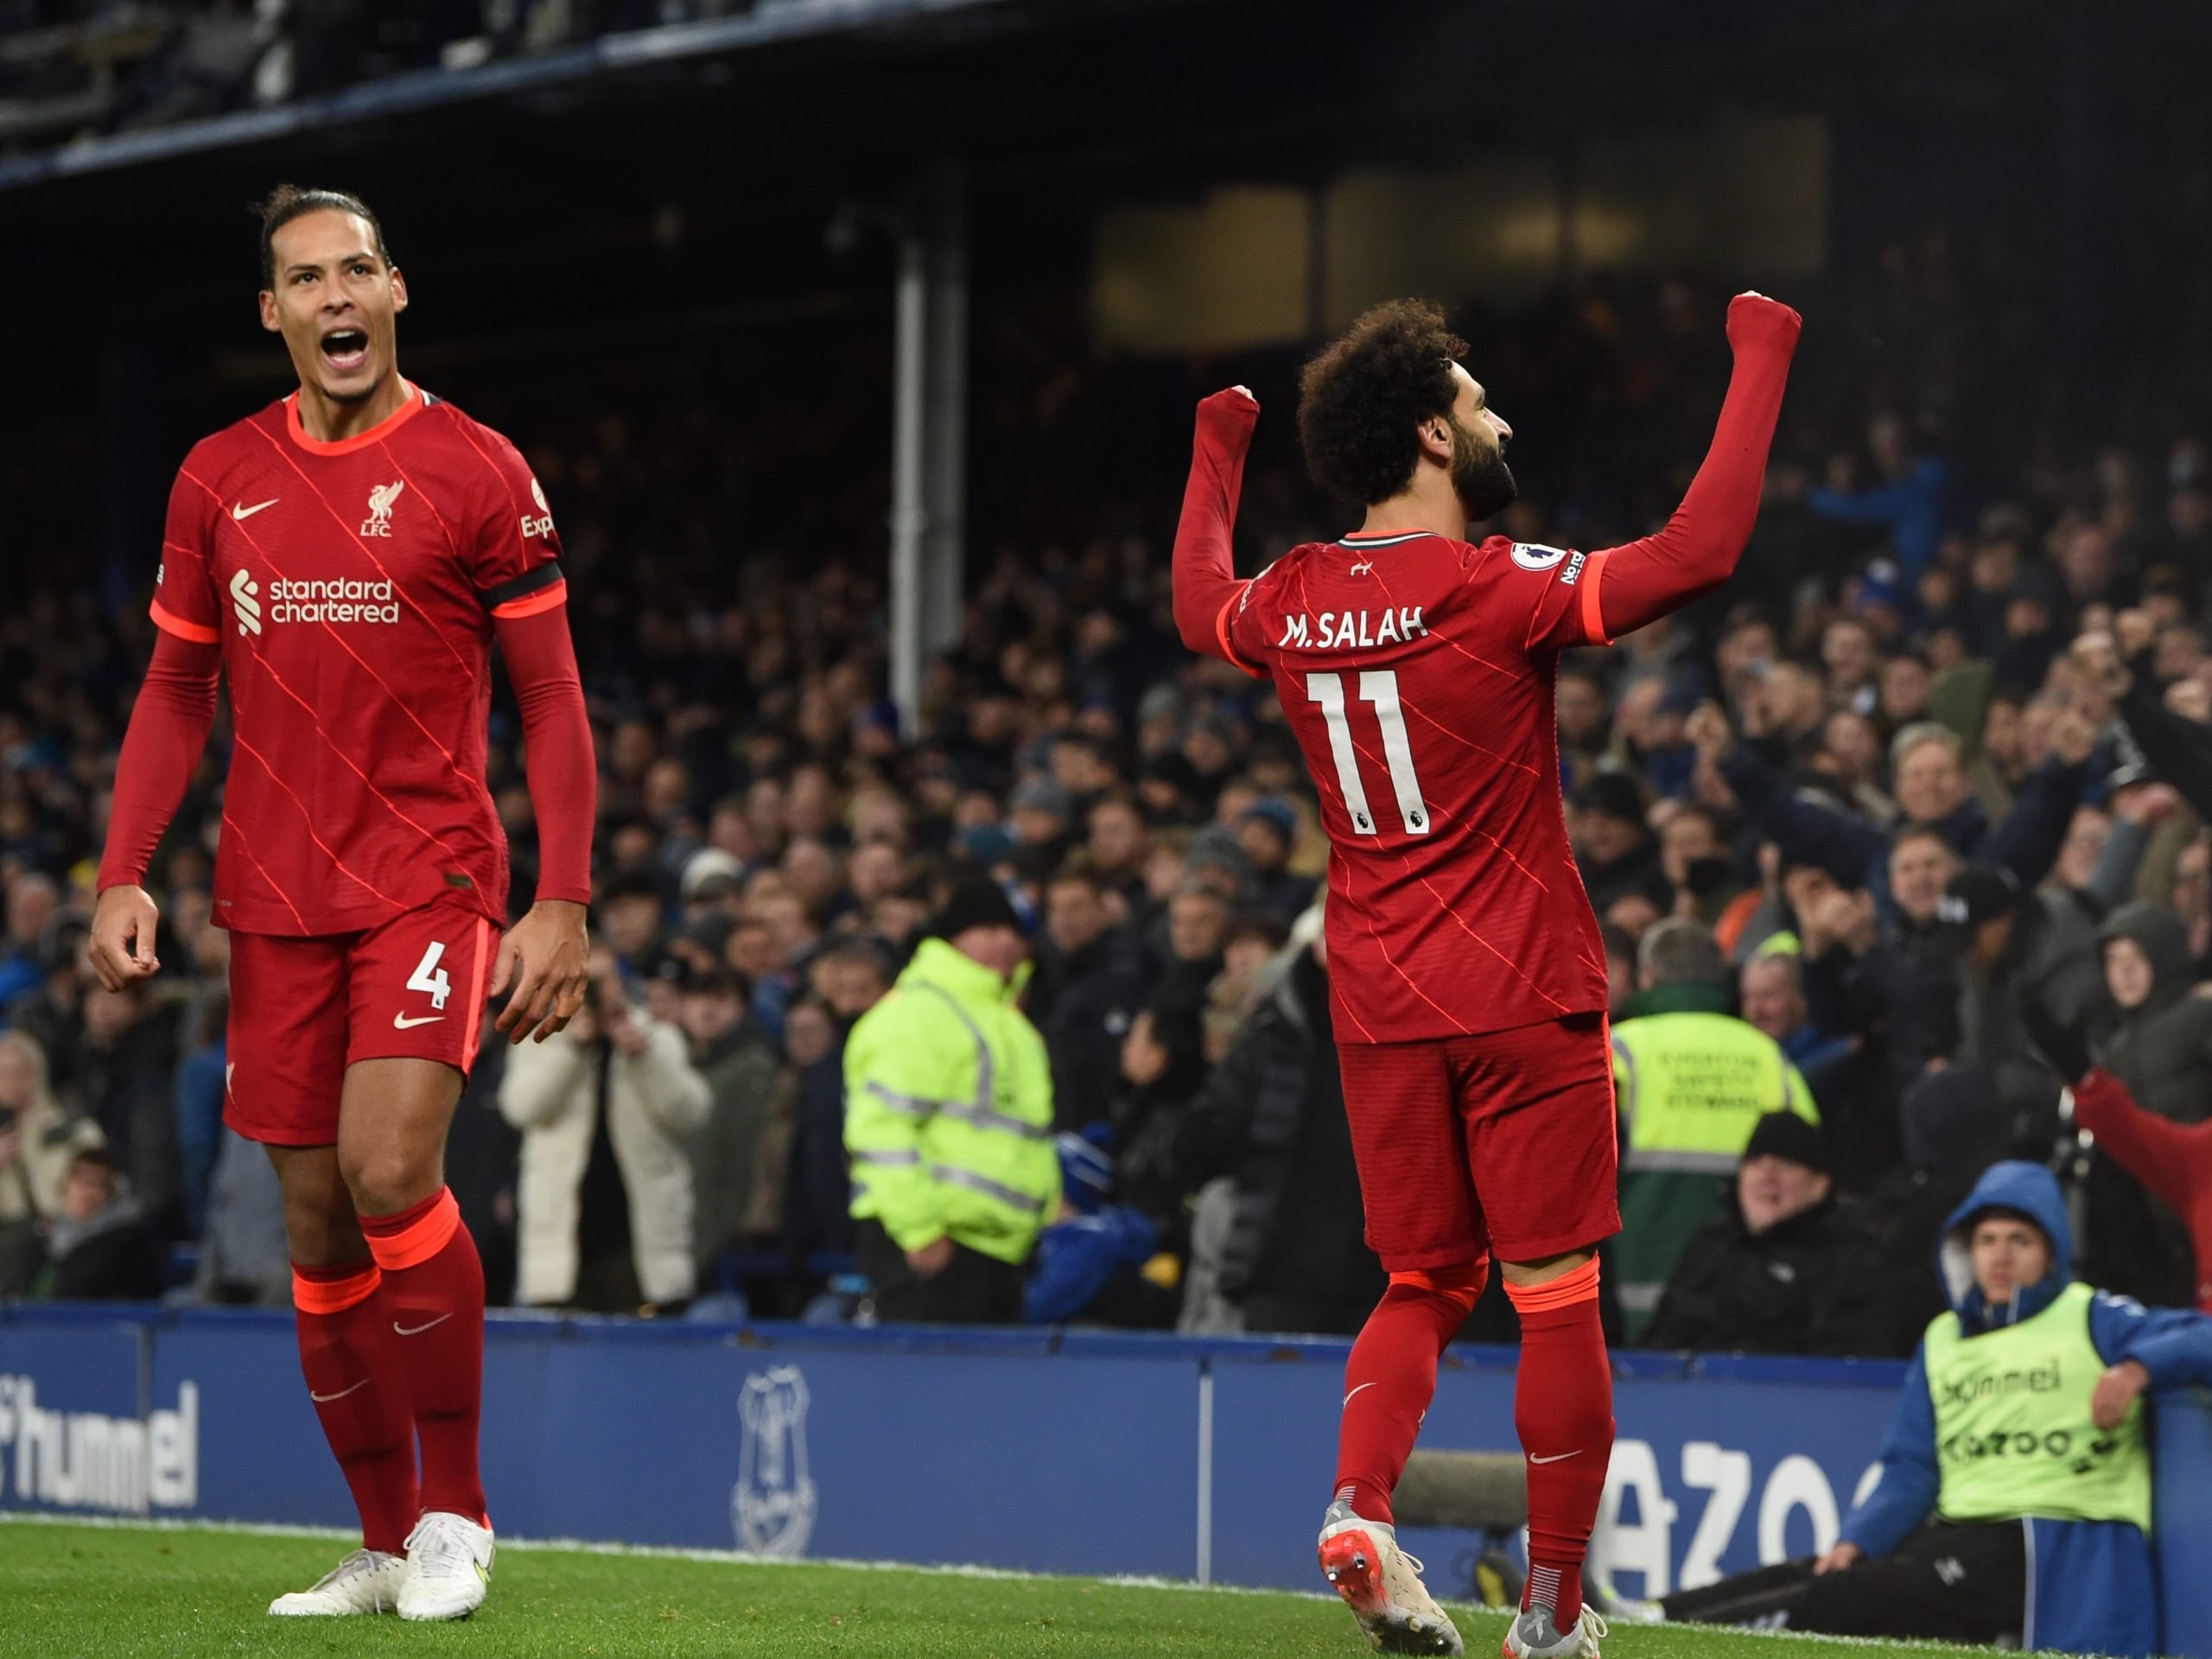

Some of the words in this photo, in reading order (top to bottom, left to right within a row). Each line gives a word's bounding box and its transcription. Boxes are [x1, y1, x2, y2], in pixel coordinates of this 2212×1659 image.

[359, 524, 392, 537] L.F.C.
[270, 576, 392, 601] standard
[1560, 566, 1577, 585] No
[270, 601, 399, 624] chartered
[1278, 607, 1428, 648] M.SALAH
[1306, 670, 1430, 836] 11
[406, 941, 451, 1010] 4
[1588, 1438, 1884, 1600] AZO
